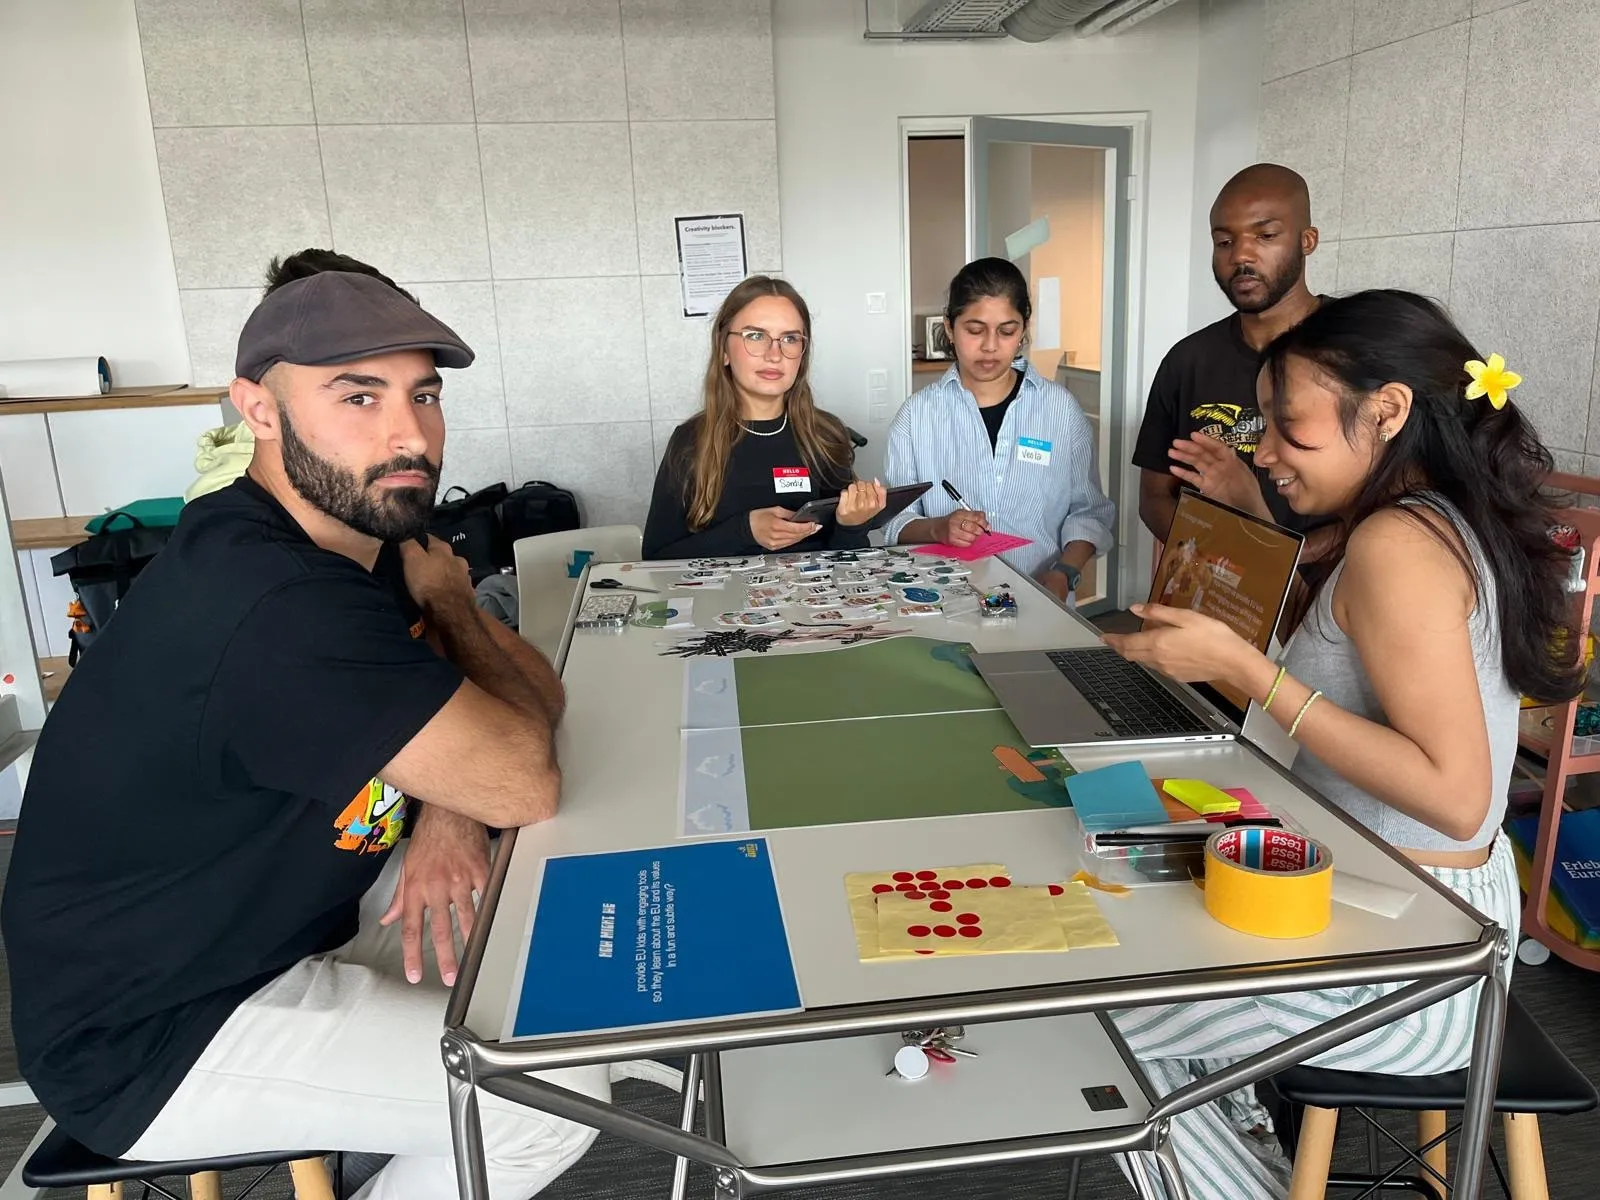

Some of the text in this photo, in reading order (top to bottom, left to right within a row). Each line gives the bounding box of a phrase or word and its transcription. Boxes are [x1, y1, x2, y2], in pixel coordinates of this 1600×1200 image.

[1271, 835, 1302, 852] tesa
[1271, 846, 1302, 863] tesa
[664, 884, 675, 902] way?
[665, 904, 674, 923] subtle
[600, 916, 615, 938] MIGHT
[636, 870, 648, 992] provide EU kids with engaging tools
[651, 861, 663, 1002] so they learn about the EU and its values
[666, 925, 675, 938] and
[598, 940, 613, 958] HOW
[666, 940, 675, 951] fun
